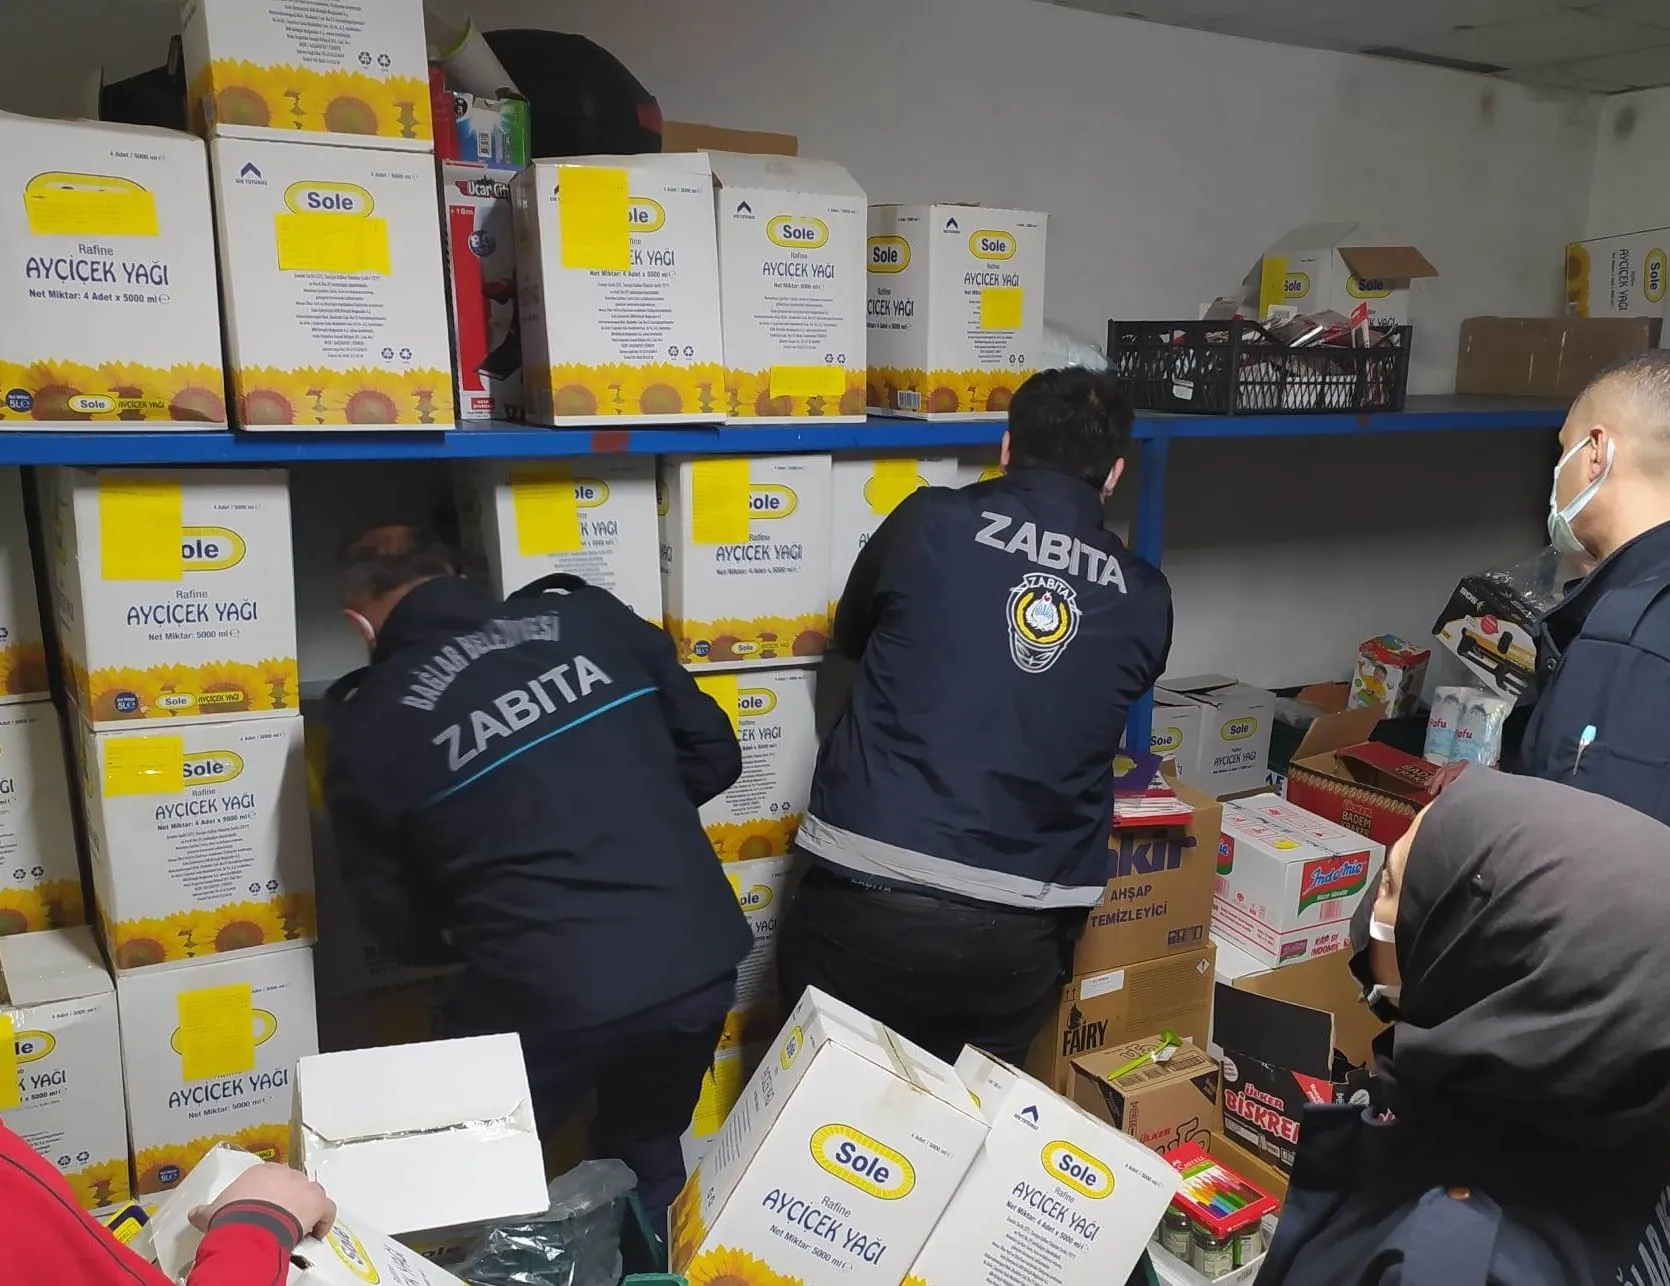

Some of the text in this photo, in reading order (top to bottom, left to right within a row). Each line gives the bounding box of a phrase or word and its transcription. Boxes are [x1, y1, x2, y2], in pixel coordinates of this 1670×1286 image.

[307, 190, 354, 211] Sole
[629, 208, 649, 223] le
[783, 223, 815, 241] Sole
[78, 243, 114, 256] Rafine
[873, 246, 898, 264] Sole
[981, 238, 1007, 253] Sole
[647, 247, 676, 266] YAĞI
[26, 255, 169, 287] AYÇİÇEK YAĞI
[811, 261, 835, 279] YAĞI
[964, 271, 1020, 288] AYÇİÇEK YAĞI
[1649, 261, 1661, 291] Sole
[1284, 279, 1302, 292] Sole
[1358, 278, 1384, 292] Sole
[29, 289, 46, 299] Net
[48, 289, 81, 301] Miktar:
[83, 292, 89, 300] 4
[92, 292, 113, 302] Adet
[123, 294, 145, 304] 5000
[147, 295, 158, 304] ml
[893, 297, 915, 317] YAĞI
[80, 399, 106, 409] Sole
[575, 486, 594, 499] le
[716, 544, 772, 564] AYÇİÇEK
[975, 510, 1128, 594] ZABITA
[176, 589, 208, 599] Rafine
[1029, 576, 1071, 600] ZABITA
[127, 598, 258, 628] AYÇİÇEK YAĞI
[148, 629, 229, 642] Net Miktar: 5000 ml
[400, 644, 471, 712] BAĞLAR
[164, 693, 240, 706] Sole AYÇİÇEK YAĞI
[431, 654, 614, 772] ZABITA
[758, 726, 782, 741] YAĞI
[1229, 723, 1250, 735] Sole
[183, 761, 224, 778] Sole
[192, 788, 216, 797] Rafine
[156, 792, 256, 821] AYÇİÇEK YAĞI
[157, 824, 170, 833] Net
[170, 820, 194, 830] Miktar:
[201, 817, 216, 826] Adet
[222, 814, 238, 823] 5000
[1342, 810, 1371, 829] BADEM
[1311, 860, 1363, 888] Indomie
[1110, 884, 1153, 903] AHŞAP
[1090, 901, 1168, 929] TEMİZLEYİCİ
[755, 919, 778, 933] YAĞI
[1063, 1018, 1109, 1057] FAIRY
[15, 1041, 34, 1055] le
[31, 1069, 67, 1090] YAĞI
[168, 1066, 289, 1109] AYÇİÇEK YAĞI
[1244, 1082, 1286, 1112] ÜLKER
[188, 1111, 202, 1120] Net
[203, 1105, 231, 1117] Miktar:
[232, 1100, 251, 1111] 5000
[835, 1141, 890, 1184] Sole
[1057, 1153, 1098, 1188] Sole
[1053, 1185, 1076, 1205] Rafine
[821, 1194, 852, 1218] Rafine
[1011, 1180, 1100, 1242] AYÇİÇEK YAĞI
[762, 1188, 888, 1265] AYÇİÇEK YAĞI
[1005, 1200, 1018, 1213] Net
[1017, 1205, 1037, 1222] Miktar:
[1041, 1219, 1056, 1234] Adet
[1059, 1231, 1074, 1246] 5000
[769, 1224, 843, 1269] Net Miktar: 5000 ml
